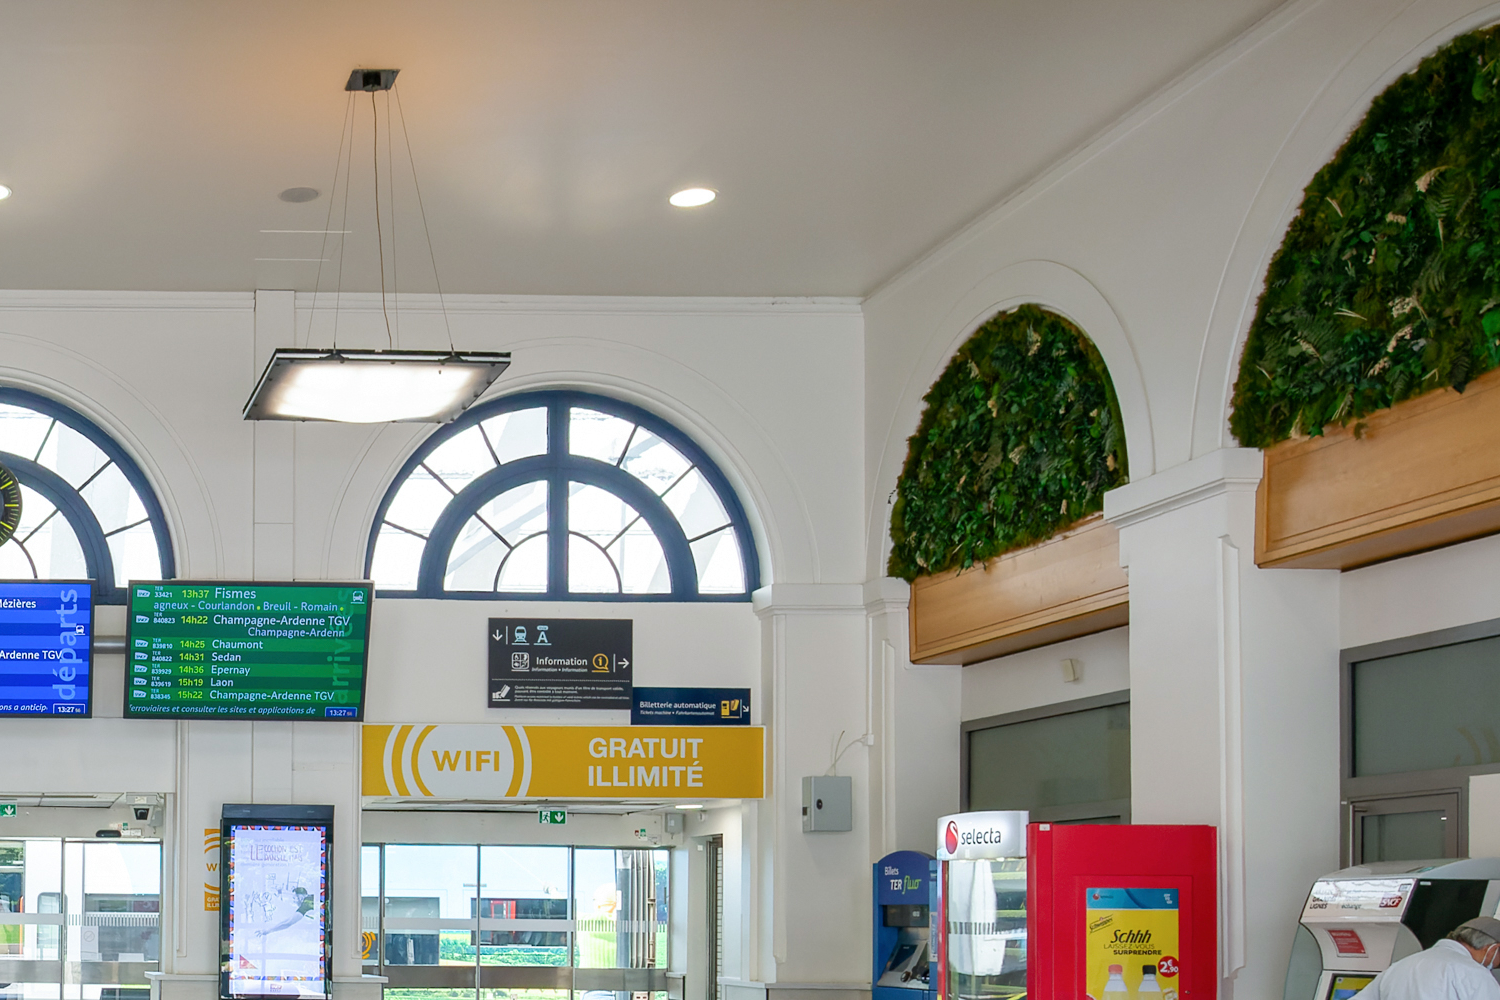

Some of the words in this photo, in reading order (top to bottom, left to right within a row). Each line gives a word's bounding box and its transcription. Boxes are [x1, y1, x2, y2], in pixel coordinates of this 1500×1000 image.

[181, 589, 210, 598] 13h37
[214, 587, 257, 599] Fismes
[153, 601, 189, 611] agneux
[198, 600, 255, 611] Courlandon
[263, 601, 291, 611] Breuil
[301, 602, 338, 612] Romain
[181, 615, 208, 624] 14h22
[213, 614, 325, 627] Champagne-Ardenne
[328, 615, 351, 626] TGV
[247, 626, 345, 639] Champagne-Ardenn
[537, 631, 548, 643] A
[52, 588, 83, 700] départs
[179, 640, 206, 649] 14h25
[211, 639, 264, 649] Chaumont
[42, 650, 62, 660] TGV
[179, 652, 205, 661] 14h31
[211, 652, 242, 662] Sedan
[536, 656, 588, 666] Information
[178, 665, 204, 674] 14h36
[211, 664, 251, 676] Epernay
[178, 678, 204, 687] 15h19
[210, 677, 234, 687] Laon
[177, 690, 203, 699] 15h22
[209, 689, 312, 701] Champagne-Ardenne
[314, 691, 334, 701] TGV
[171, 705, 180, 713] et
[181, 705, 216, 713] consulter
[217, 705, 228, 713] les
[229, 706, 247, 714] sites
[248, 706, 257, 714] et
[258, 706, 305, 715] applications
[305, 707, 316, 715] de
[639, 701, 673, 709] Billetterie
[673, 702, 716, 710] automatique
[588, 737, 704, 759] GRATUIT
[431, 750, 500, 772] WIFI
[588, 760, 704, 788] ILLIMITÉ
[961, 827, 1002, 845] selecta
[890, 879, 902, 890] TER
[902, 875, 922, 895] fluo
[1380, 898, 1400, 907] SNCF
[1110, 929, 1152, 944] Schhh
